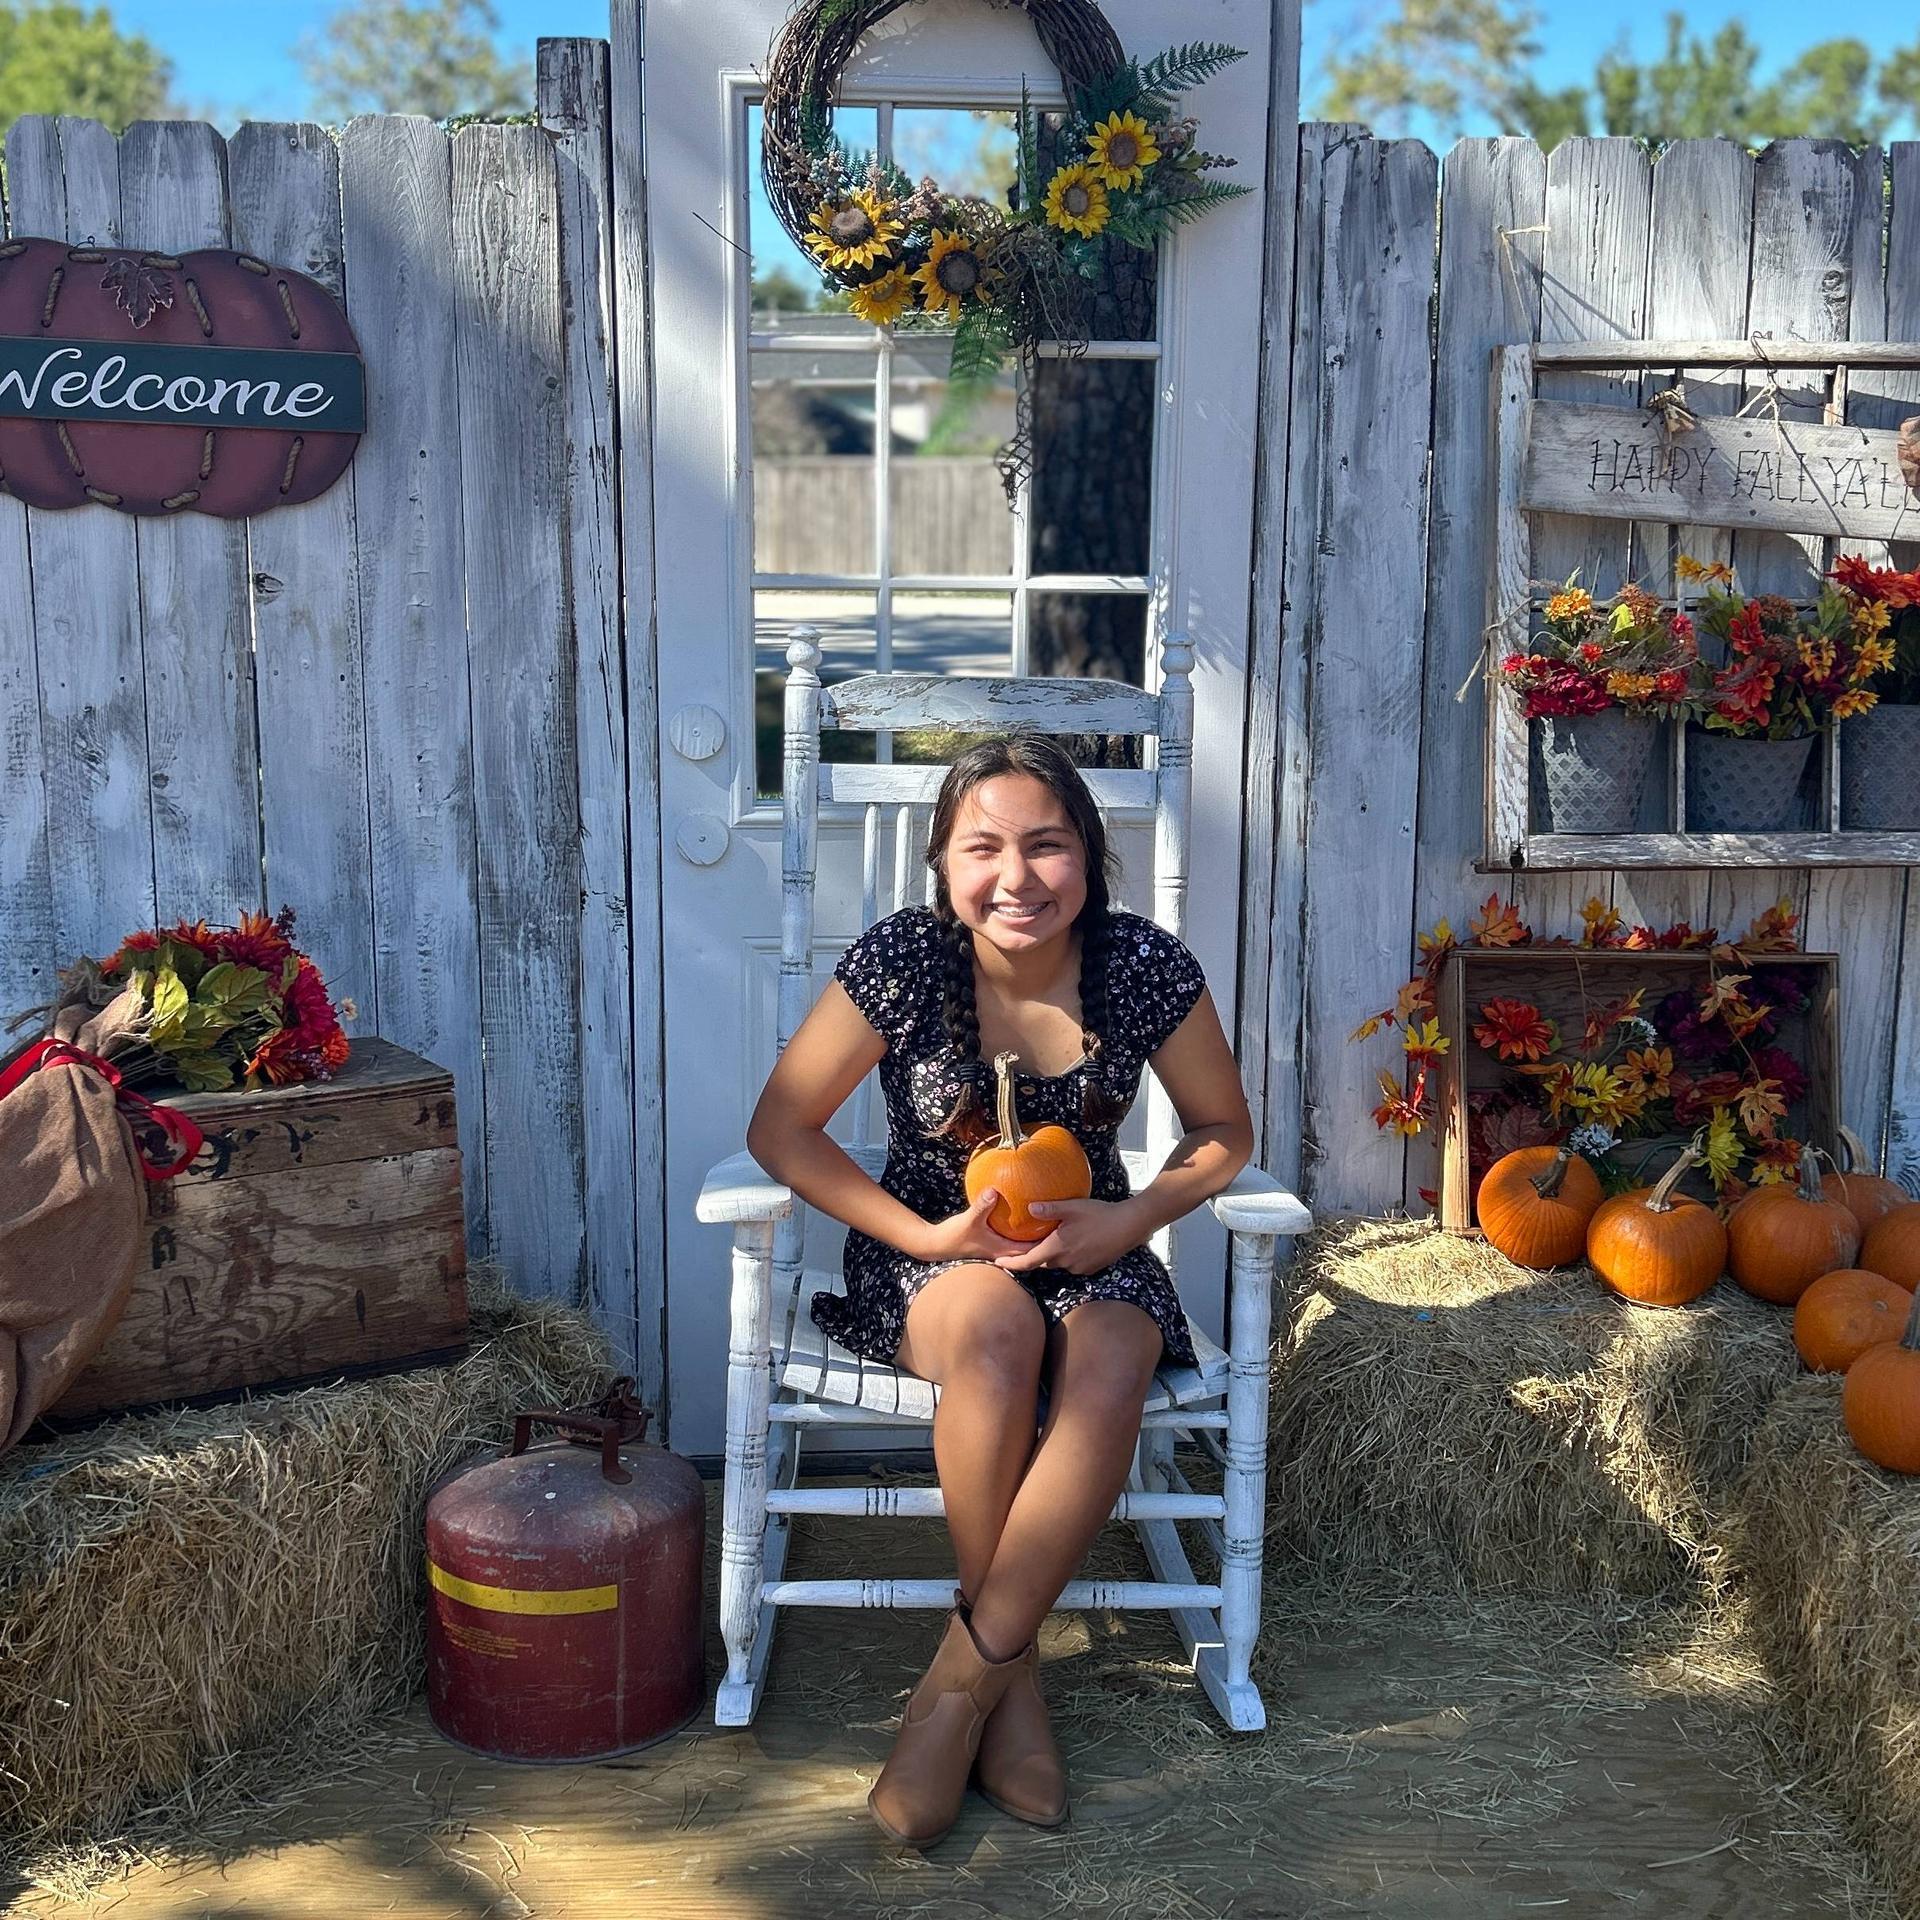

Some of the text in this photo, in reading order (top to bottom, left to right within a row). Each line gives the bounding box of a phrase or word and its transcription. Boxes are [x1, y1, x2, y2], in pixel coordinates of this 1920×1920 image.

[0, 348, 334, 417] Welcome
[1587, 438, 1717, 495] HAPPY
[1730, 448, 1818, 505] FALL
